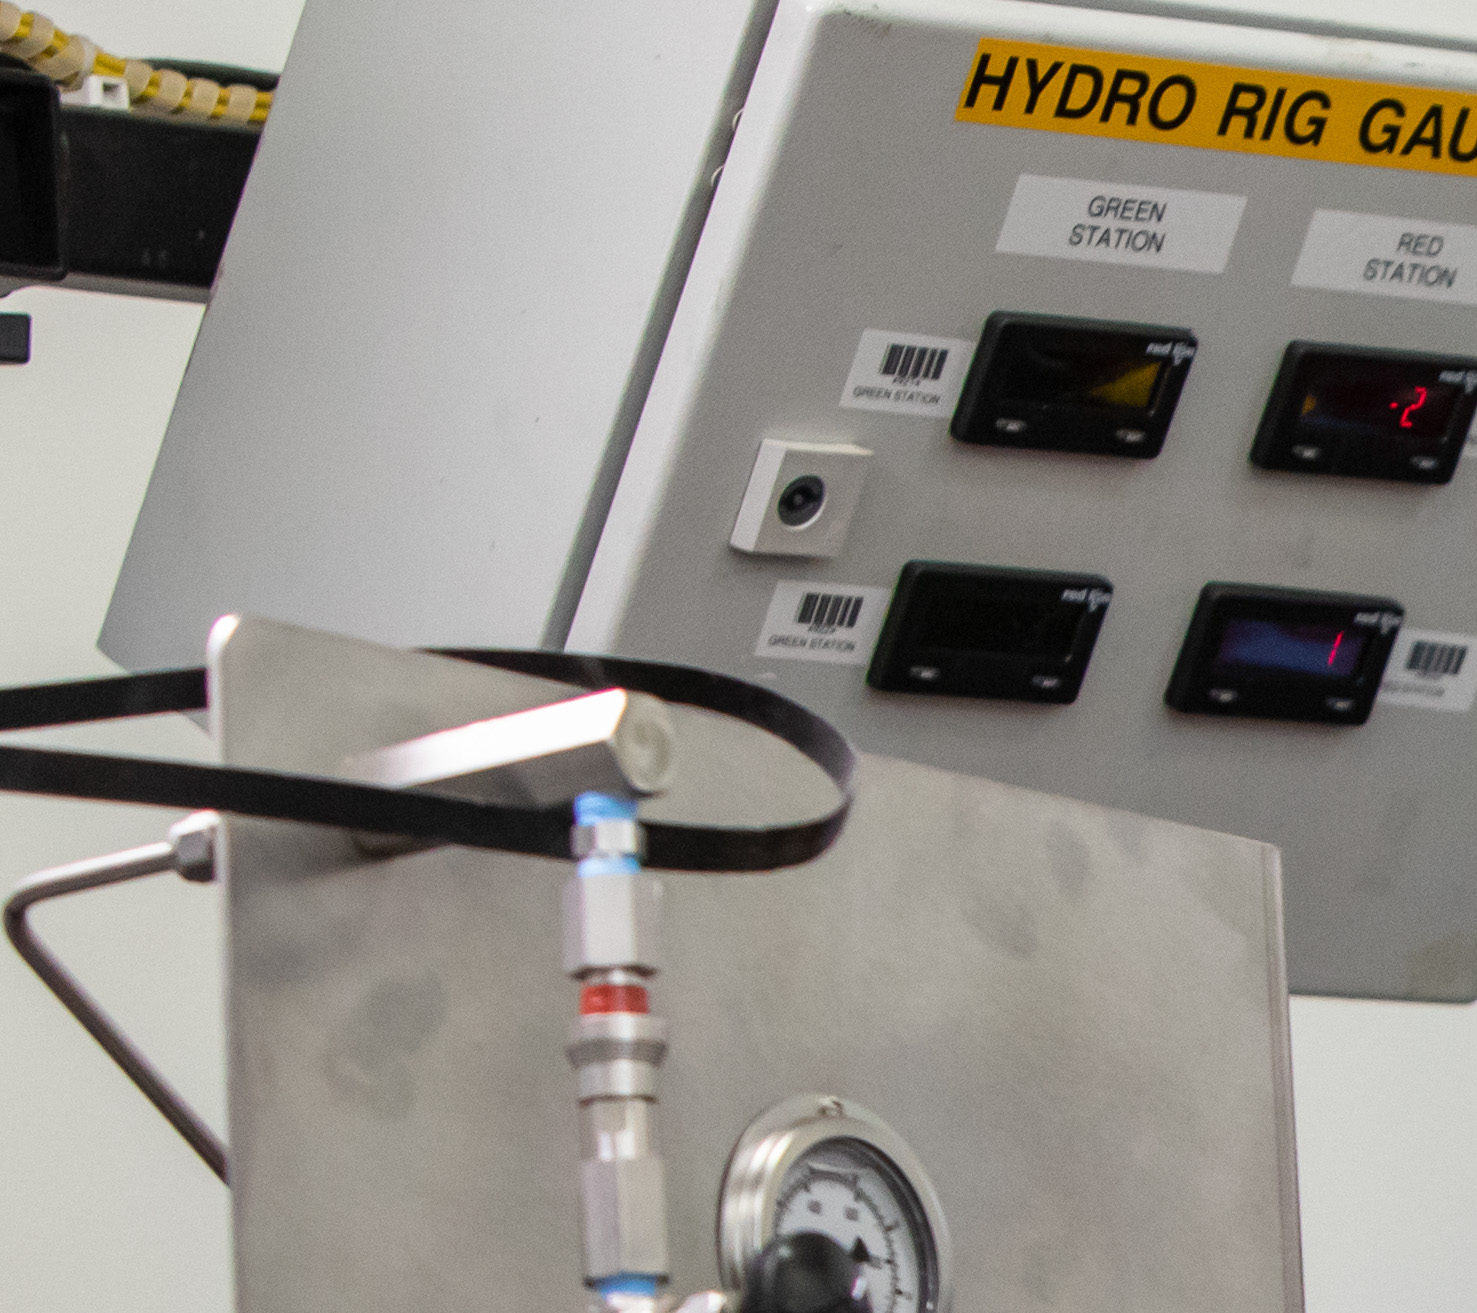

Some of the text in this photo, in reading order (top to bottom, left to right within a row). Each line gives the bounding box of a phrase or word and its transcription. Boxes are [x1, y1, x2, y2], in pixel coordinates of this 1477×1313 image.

[961, 51, 1199, 131] HYDRO
[1216, 81, 1333, 147] RIG
[1086, 195, 1168, 223] GREEN
[1067, 222, 1167, 255] STATION
[1396, 231, 1445, 258] RED
[1362, 257, 1459, 289] STATION
[852, 385, 941, 405] GREEN STATION
[767, 634, 856, 652] GREEN STATION
